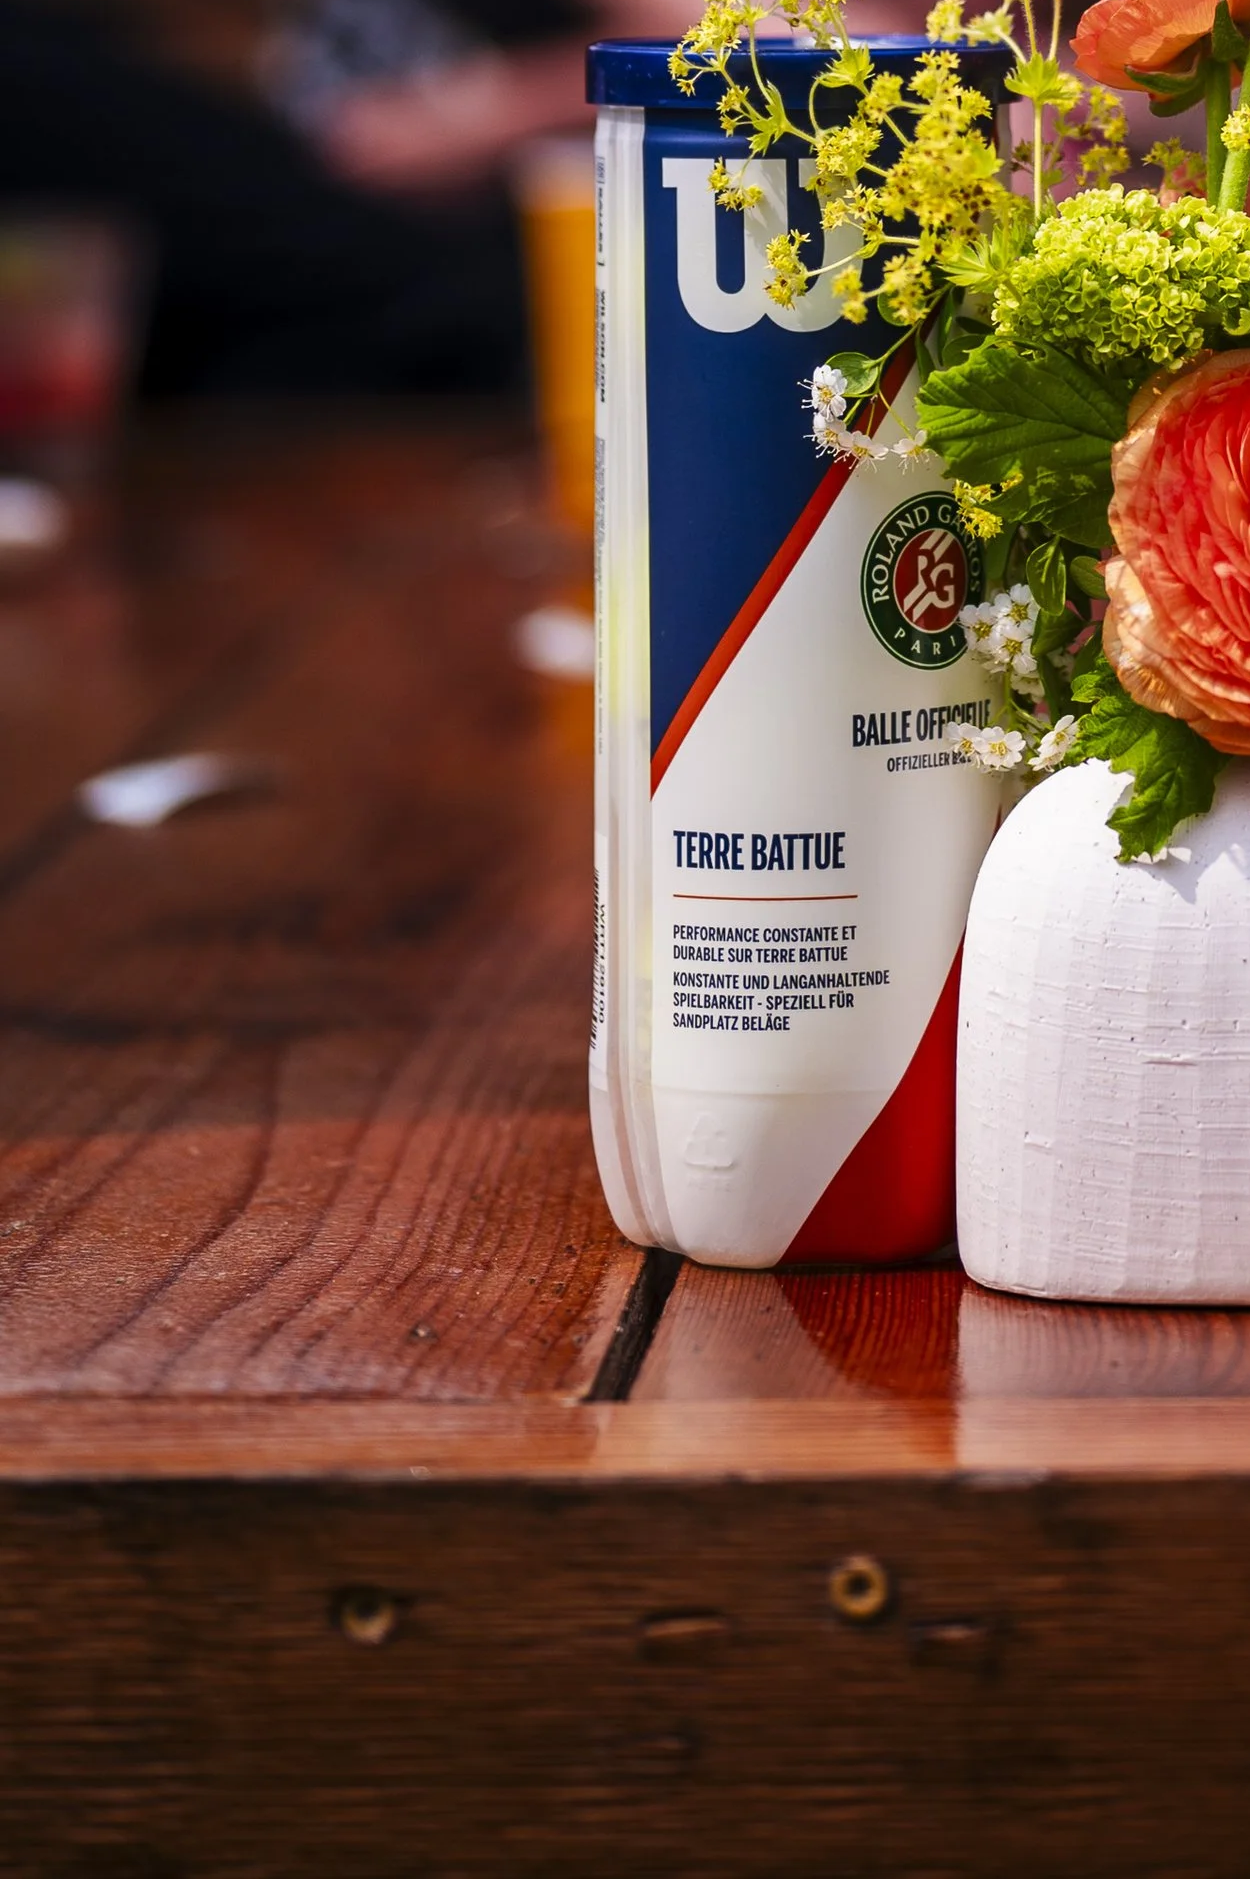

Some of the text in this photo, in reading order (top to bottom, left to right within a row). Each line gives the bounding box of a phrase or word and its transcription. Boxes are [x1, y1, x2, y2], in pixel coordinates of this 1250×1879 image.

[872, 504, 982, 603] ROLAND GAROS
[894, 627, 957, 656] PARI
[852, 710, 912, 748] BALLE
[887, 751, 950, 772] OFFIZIELLER
[673, 830, 846, 871] TERRE BATTUE
[673, 924, 857, 943] PERFORMANCE CONSTANTE ET
[673, 944, 848, 963] DURABLE SUR TERRE BATTUE
[673, 969, 890, 990] KONSTANTE UND LANGANHALTENDE
[673, 992, 755, 1011] SPIELBARKEIT
[765, 993, 826, 1011] SPEZIELL
[828, 990, 855, 1009] FÜR
[673, 1012, 791, 1032] SANDPLATZ BELÄGE
